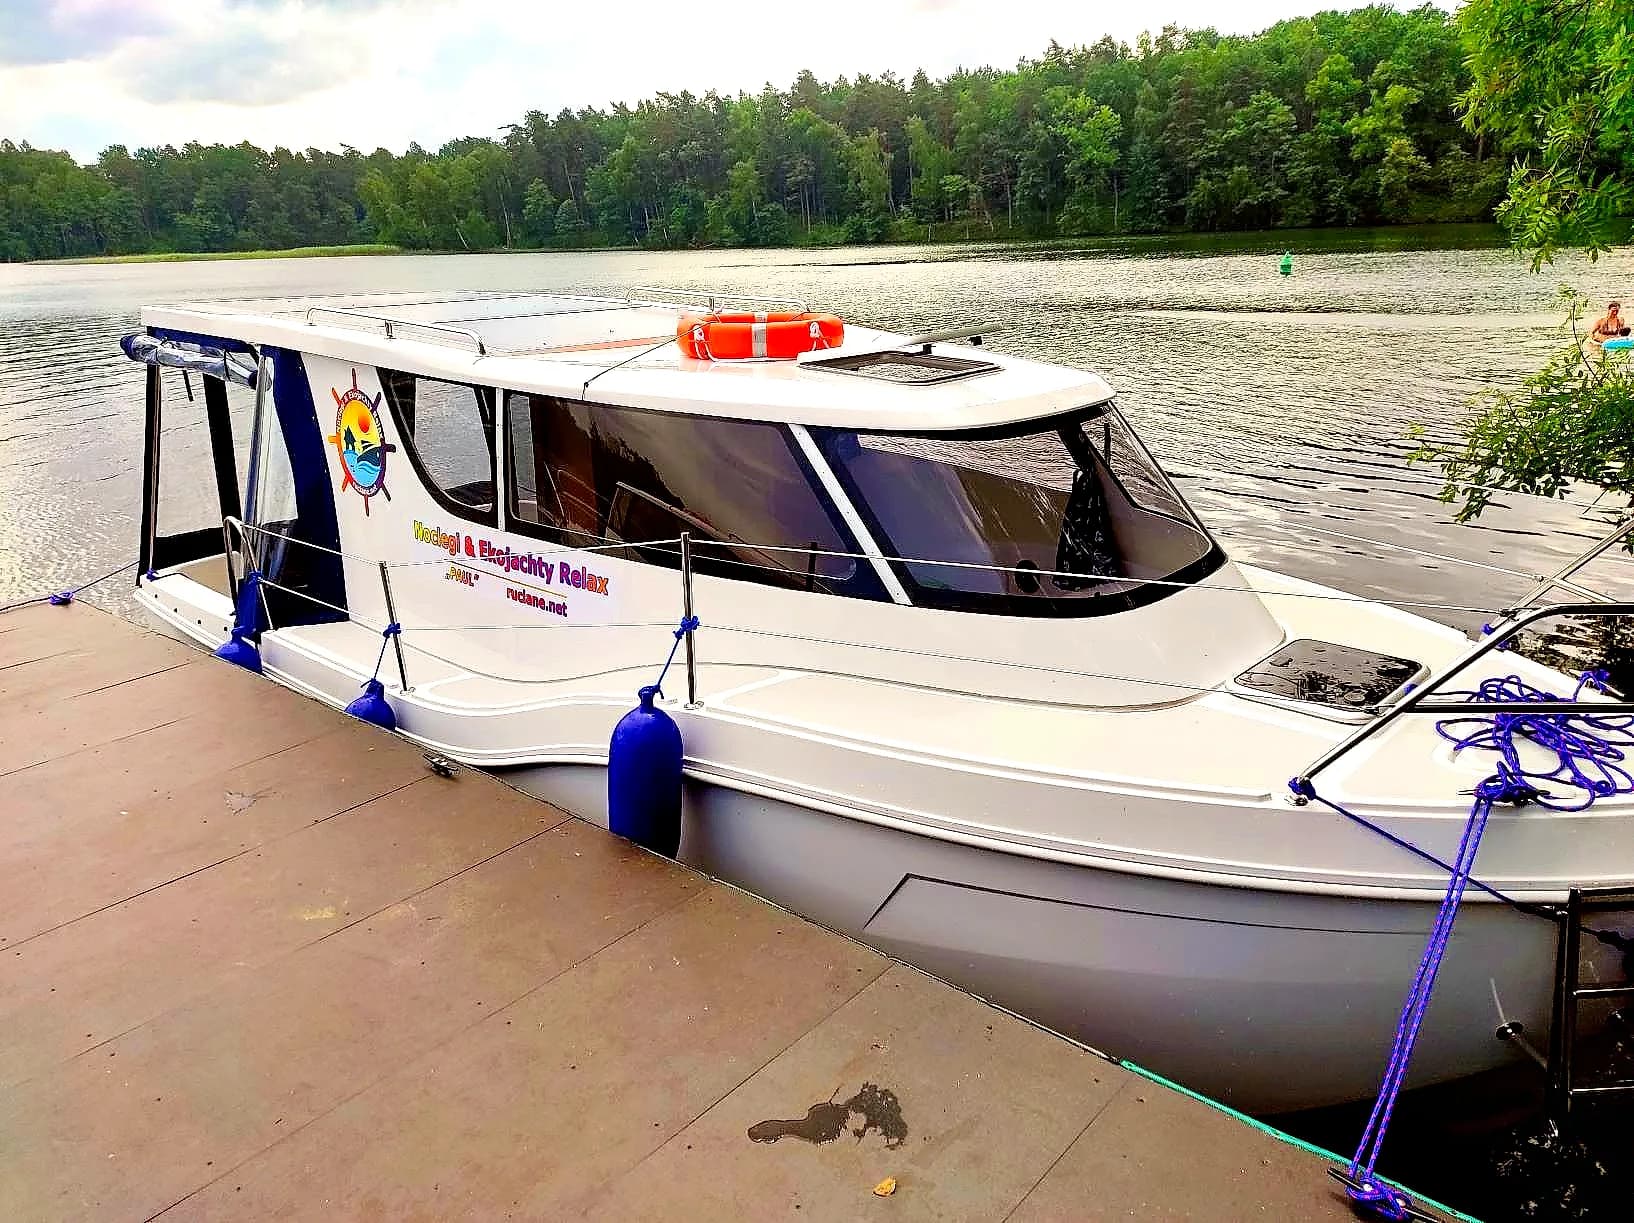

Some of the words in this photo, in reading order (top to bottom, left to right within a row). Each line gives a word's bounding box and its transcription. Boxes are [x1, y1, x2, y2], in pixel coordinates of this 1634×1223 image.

[413, 520, 460, 556] Noclegi
[464, 535, 475, 558] &
[479, 540, 555, 584] Ekojachty
[559, 561, 609, 595] Relax
